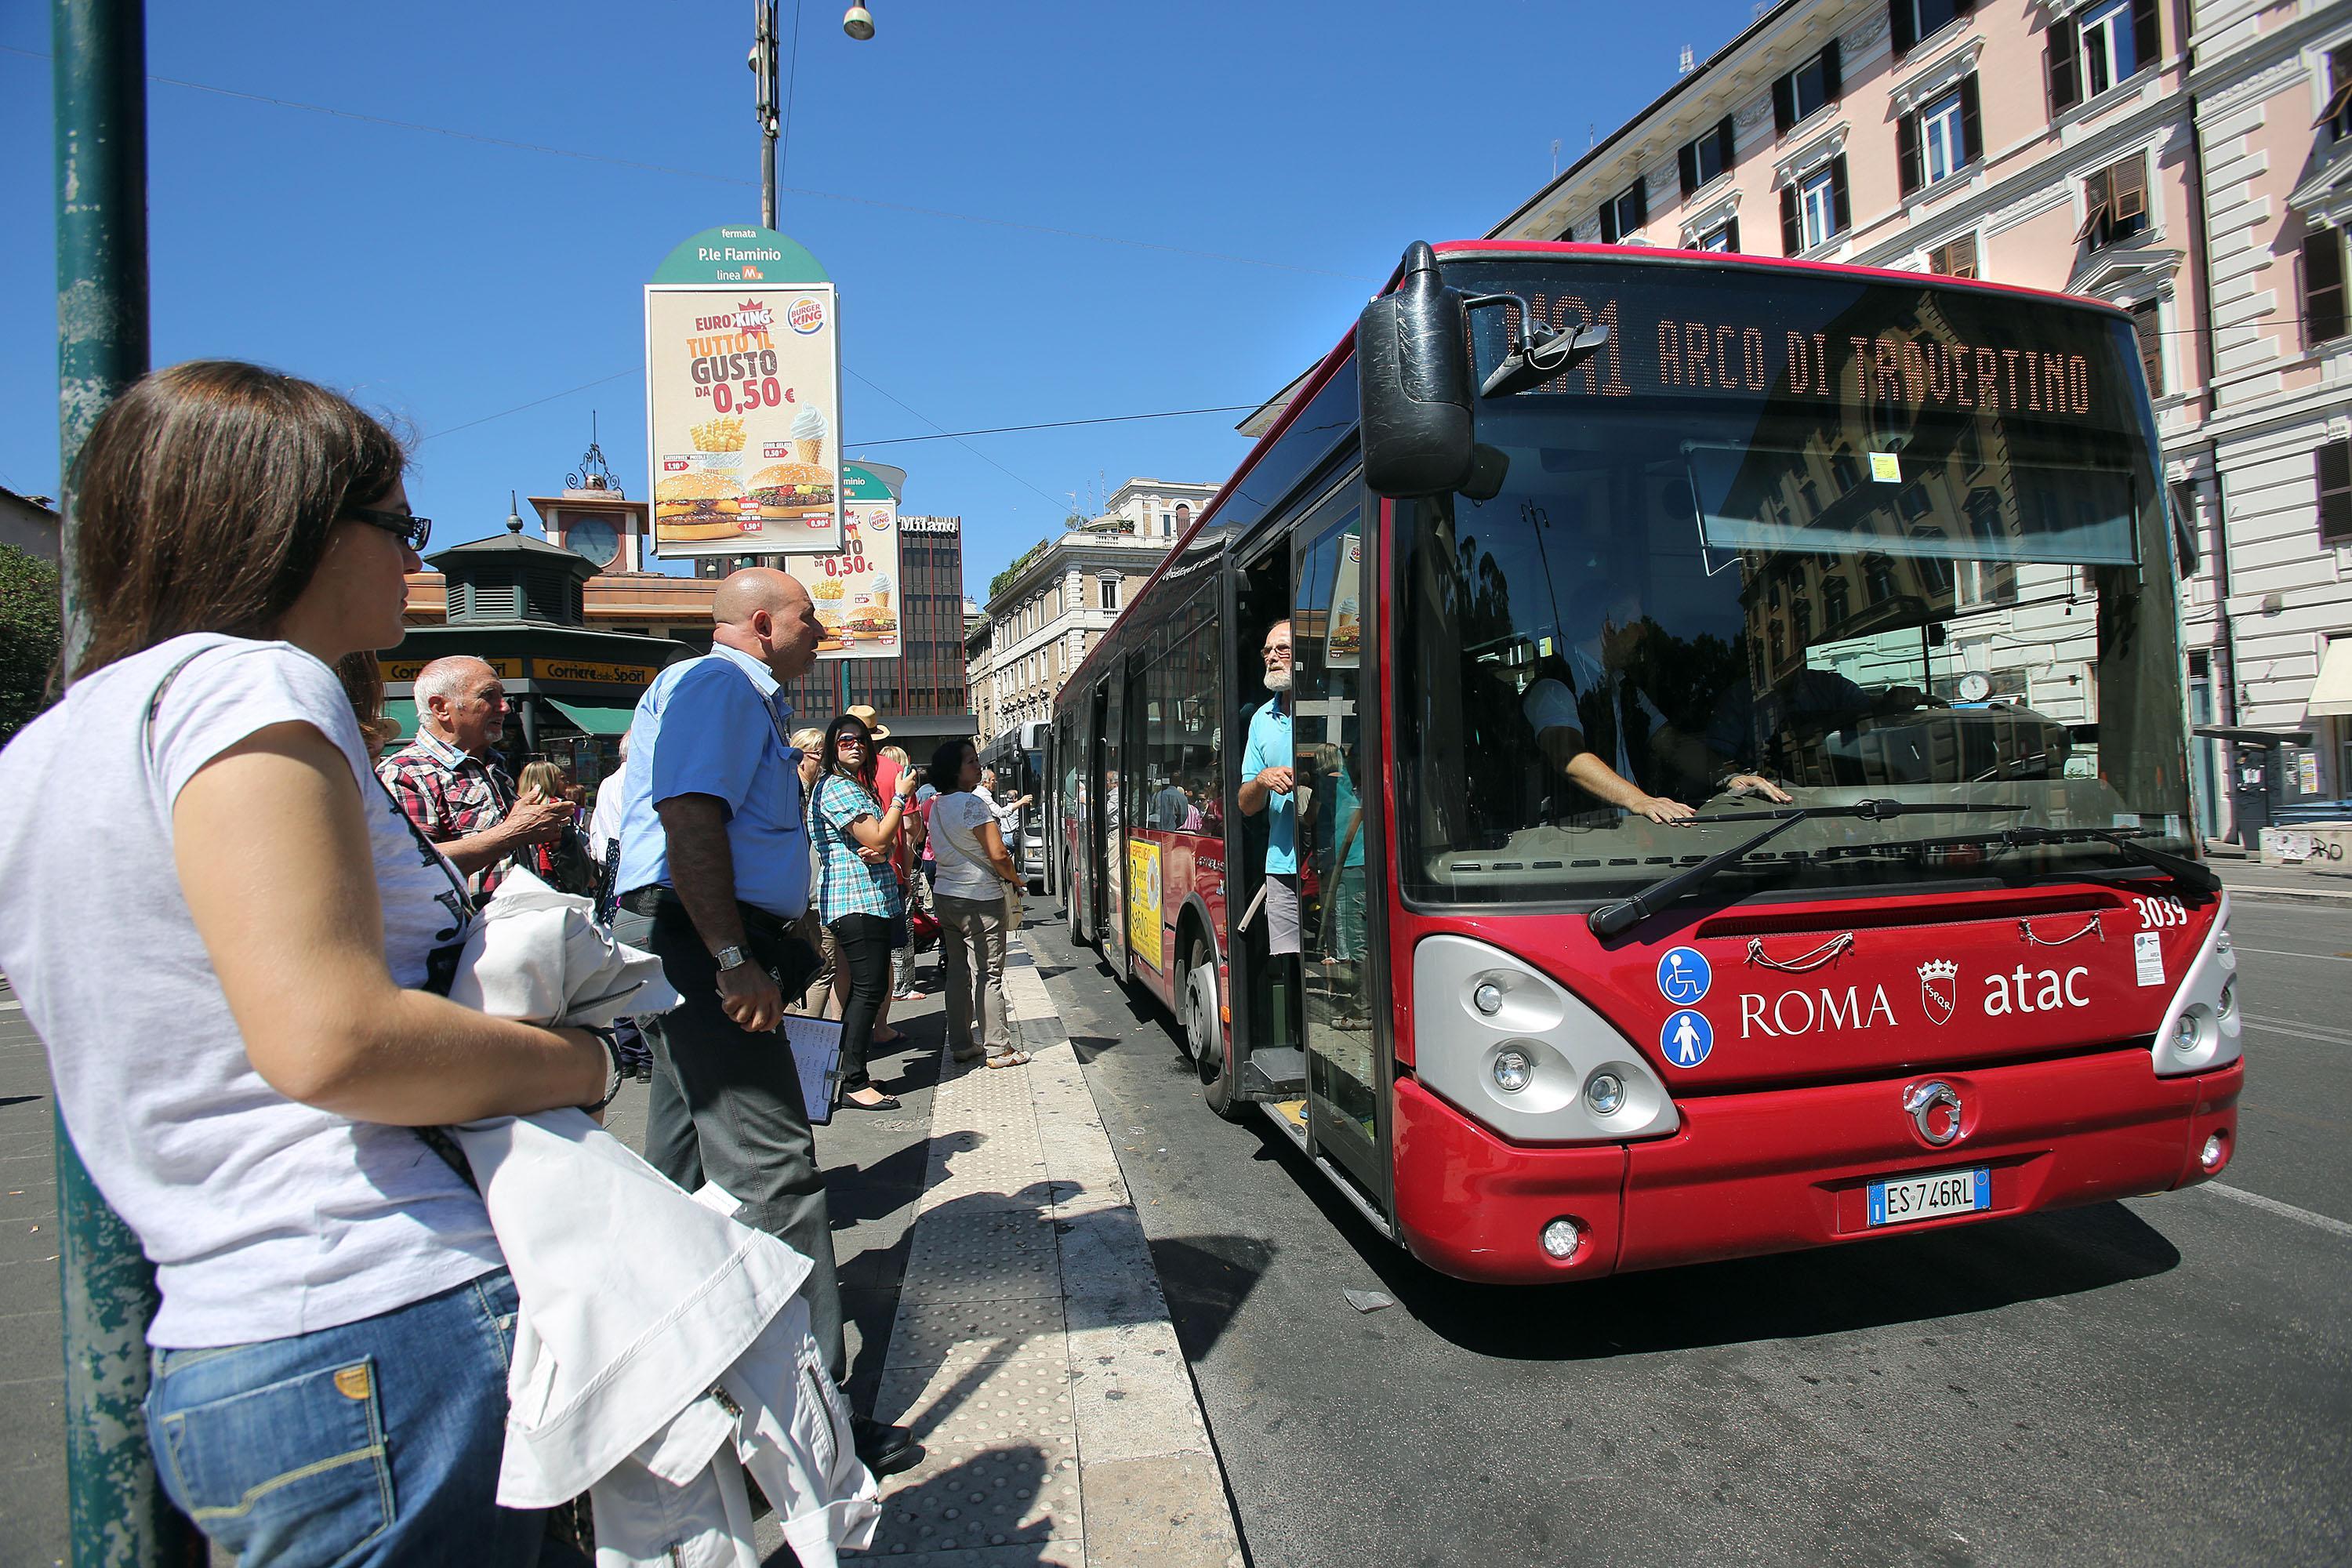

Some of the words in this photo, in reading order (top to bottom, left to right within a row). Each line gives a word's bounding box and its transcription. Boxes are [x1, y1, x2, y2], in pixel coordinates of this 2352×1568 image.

[721, 229, 757, 238] fermata
[699, 247, 721, 261] P.le
[724, 247, 782, 261] Flaminio
[717, 270, 741, 281] linea
[792, 303, 821, 318] BURGER
[793, 310, 822, 327] KING
[686, 332, 749, 358] TUTTO
[757, 331, 775, 350] IL
[691, 350, 778, 384] GUSTO
[1657, 320, 1765, 390] ARCO
[1787, 331, 1831, 396] DI
[1850, 336, 2089, 414] TRAVERTINO
[695, 386, 710, 397] DA
[872, 517, 889, 526] KING
[547, 663, 596, 680] Corriere
[614, 667, 645, 683] Sport
[2132, 895, 2187, 929] 3039
[1984, 964, 2090, 1016] atac
[1739, 983, 1899, 1039] ROMA
